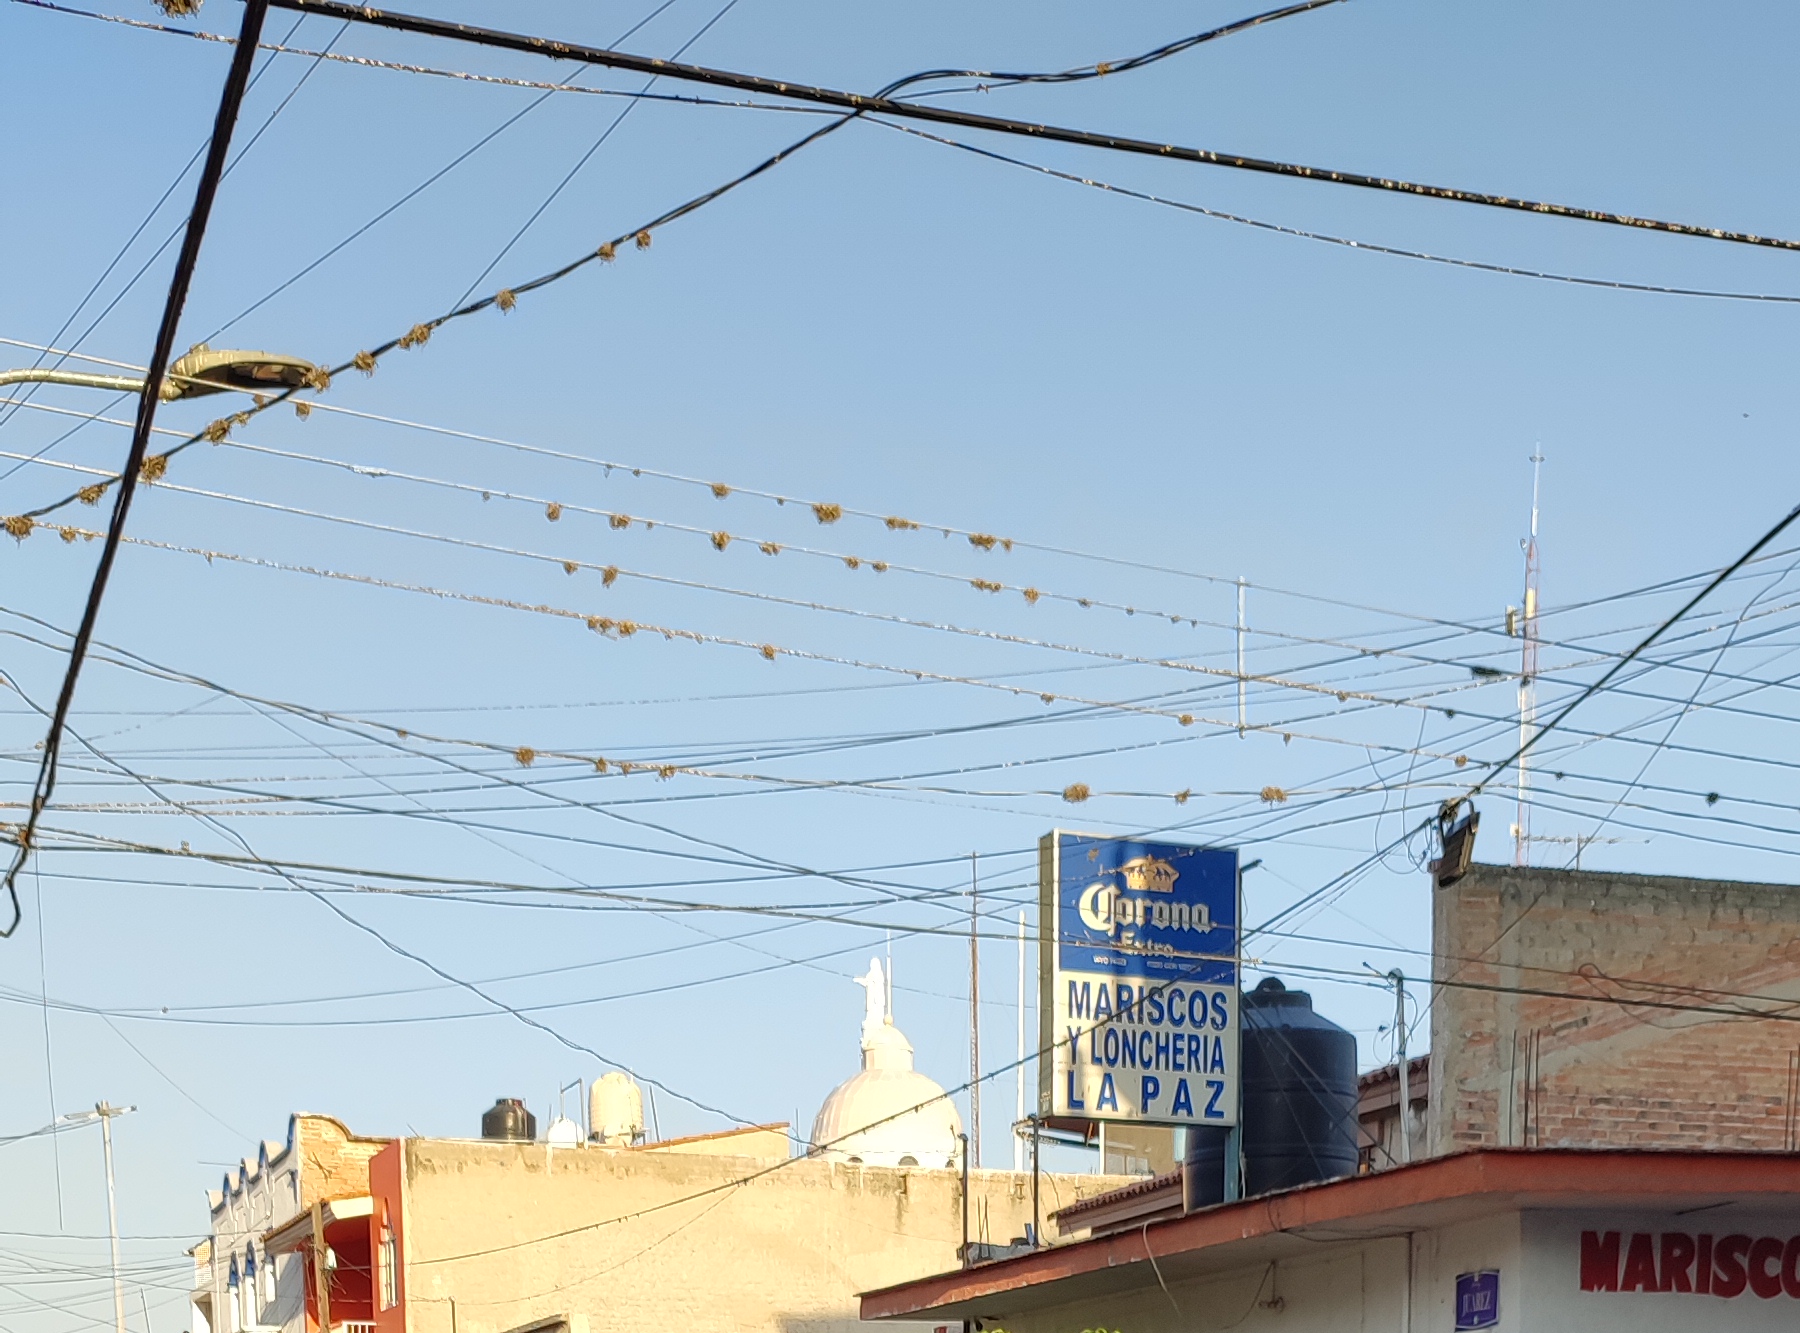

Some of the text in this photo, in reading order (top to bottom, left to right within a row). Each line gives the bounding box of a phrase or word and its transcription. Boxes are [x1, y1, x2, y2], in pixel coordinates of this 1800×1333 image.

[1079, 882, 1217, 936] Corona
[1067, 980, 1228, 1031] MARISCOS
[1067, 1025, 1226, 1075] Y LONCHERIA
